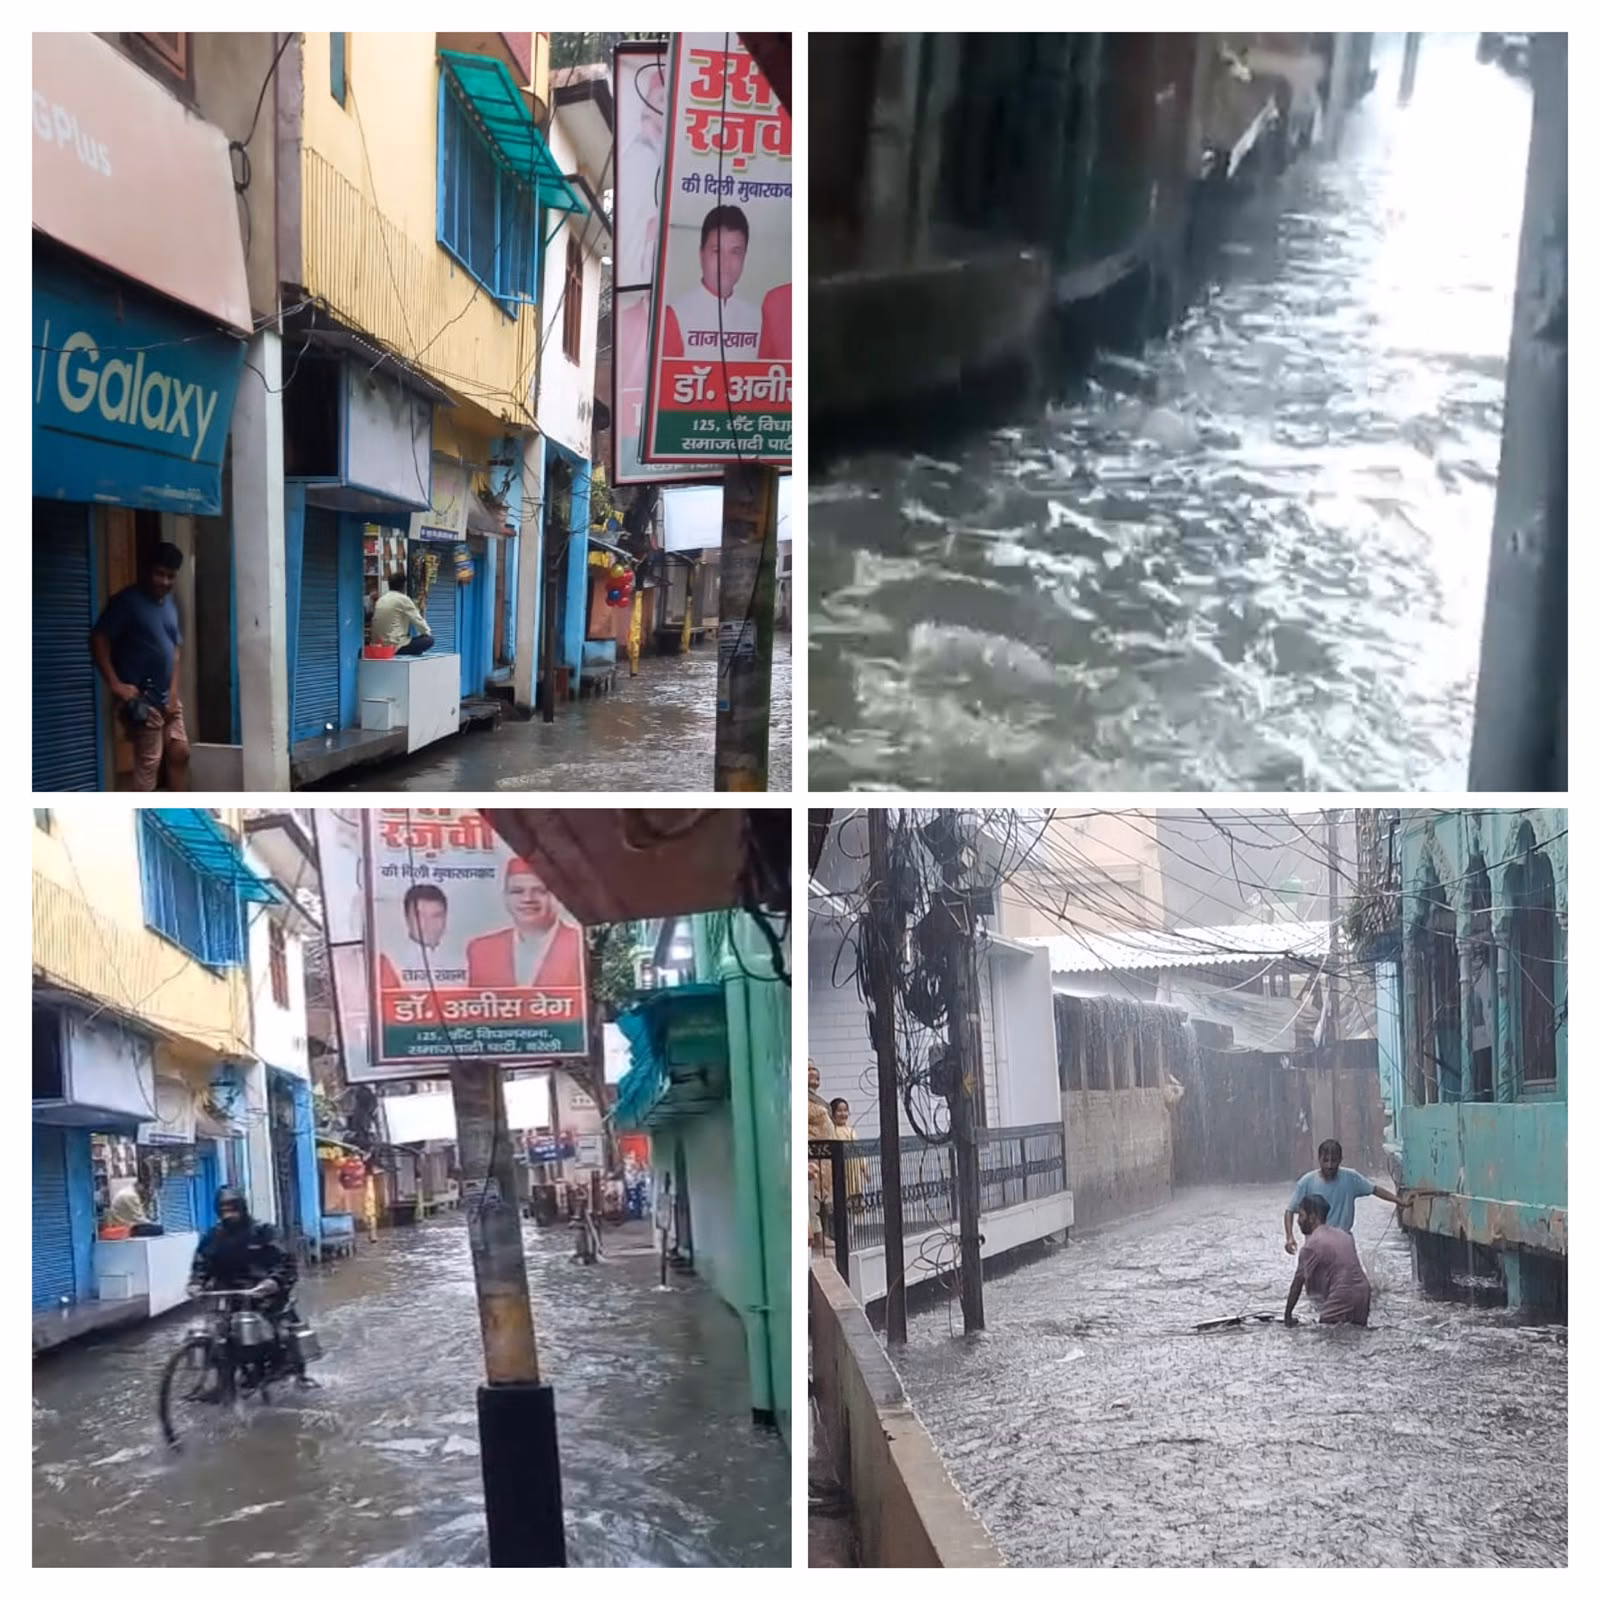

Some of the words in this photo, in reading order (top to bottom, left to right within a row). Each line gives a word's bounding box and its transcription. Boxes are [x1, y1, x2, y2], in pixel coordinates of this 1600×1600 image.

[681, 172, 700, 194] की
[704, 174, 734, 196] दिली
[687, 330, 718, 347] ताज
[723, 331, 758, 348] खान
[57, 331, 218, 461] Galaxy
[673, 365, 716, 404] डॉ.
[692, 419, 721, 432] 125,
[681, 434, 763, 450] समाजवादी
[394, 994, 433, 1021] डॉ.
[443, 992, 523, 1019] अनीस
